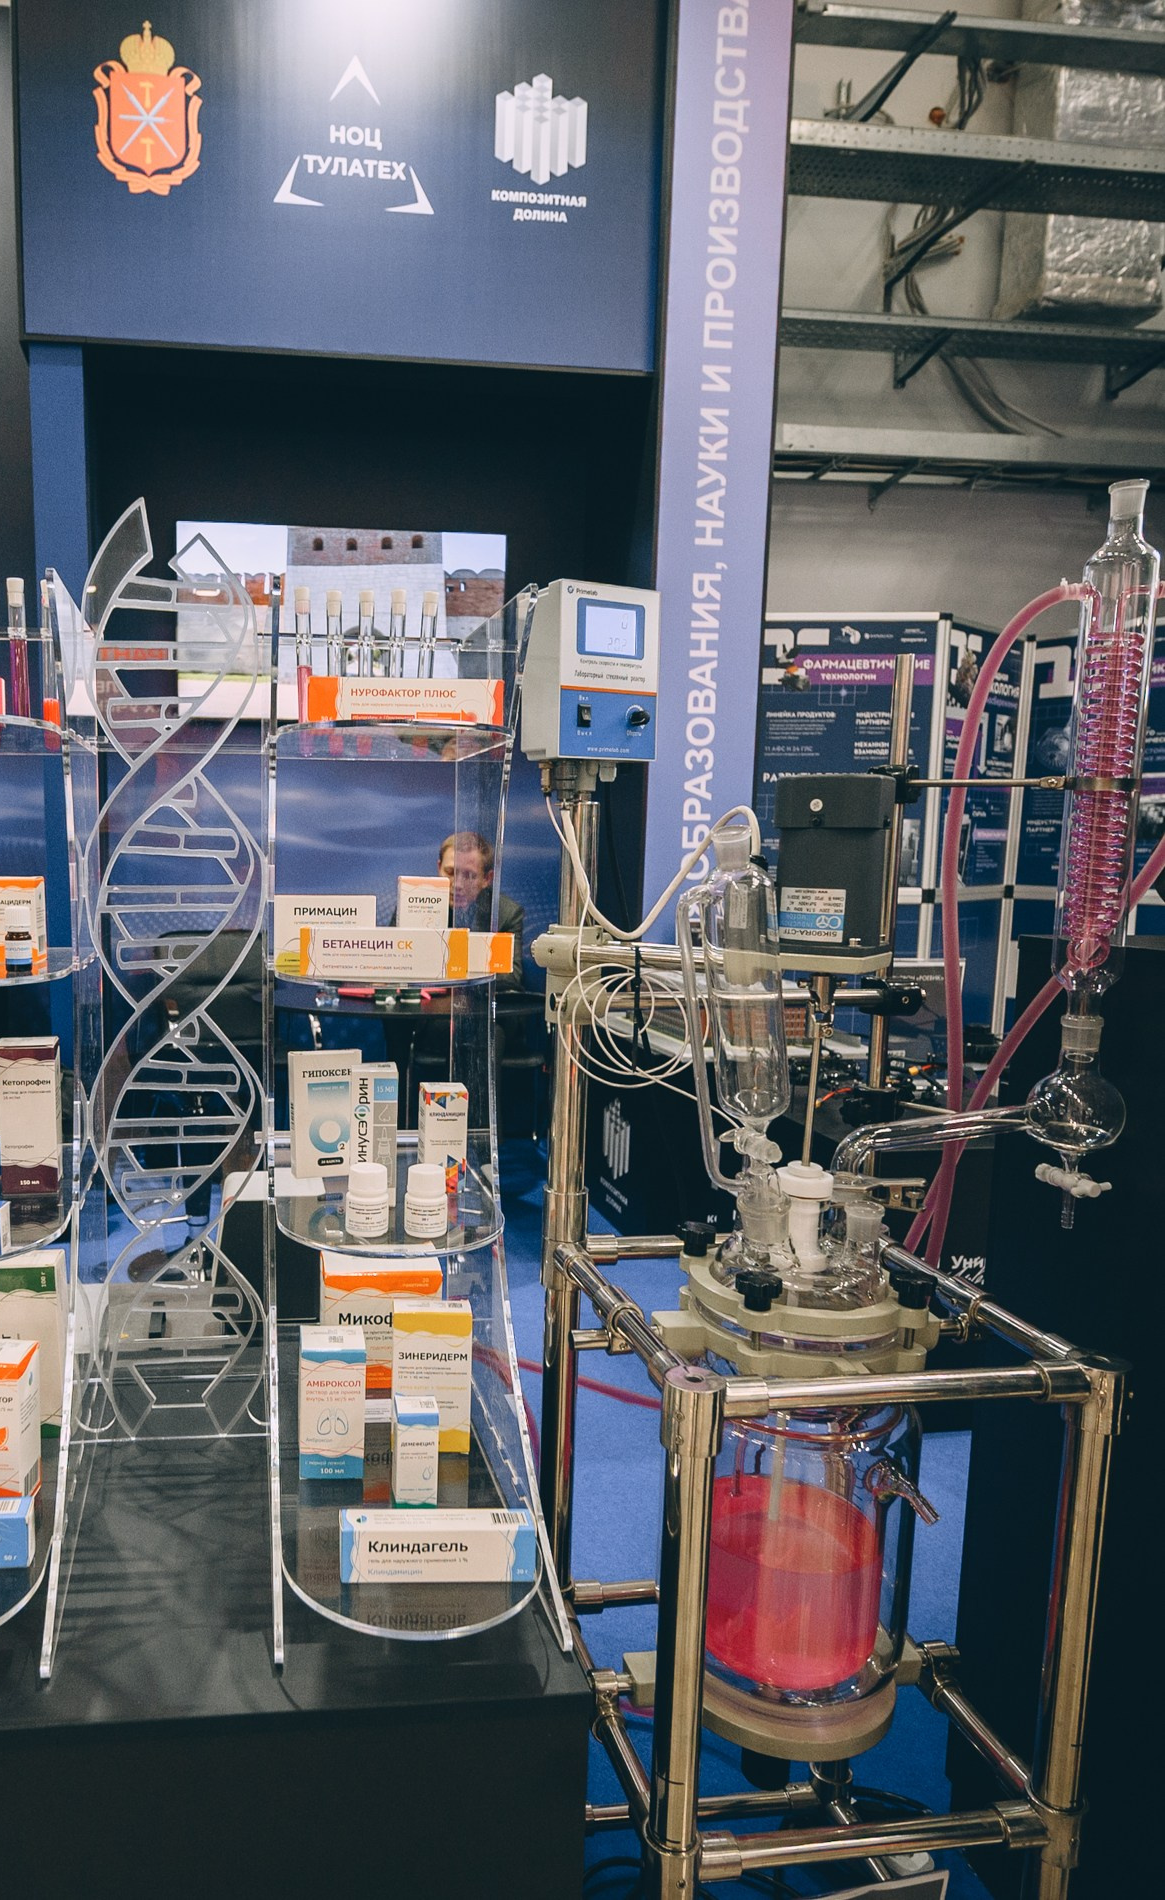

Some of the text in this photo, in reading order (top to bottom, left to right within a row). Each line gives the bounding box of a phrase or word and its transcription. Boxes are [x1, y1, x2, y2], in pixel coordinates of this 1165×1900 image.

[328, 124, 383, 151] НОЦ
[302, 153, 407, 181] ТУЛАТЕХ
[702, 0, 751, 350] ПРОИЗВОДСТВ
[490, 188, 587, 208] КОМПОЗИТНАЯ
[512, 208, 568, 223] ДОЛИНА
[701, 365, 733, 392] И
[694, 408, 730, 547] НАУКИ
[350, 688, 457, 698] НУРОФАКТОР ПЛЮС
[408, 896, 442, 904] ОТИЛОР
[293, 906, 358, 917] ПРИМАЦИН
[322, 939, 413, 950] БЕТАНЕЦИН СК
[2, 1079, 51, 1088] Кетопрофен
[398, 1351, 468, 1362] ЗИНЕРИДЕРМ
[306, 1380, 361, 1388] АМБРОКСОЛ
[368, 1540, 469, 1553] Клиндагель
